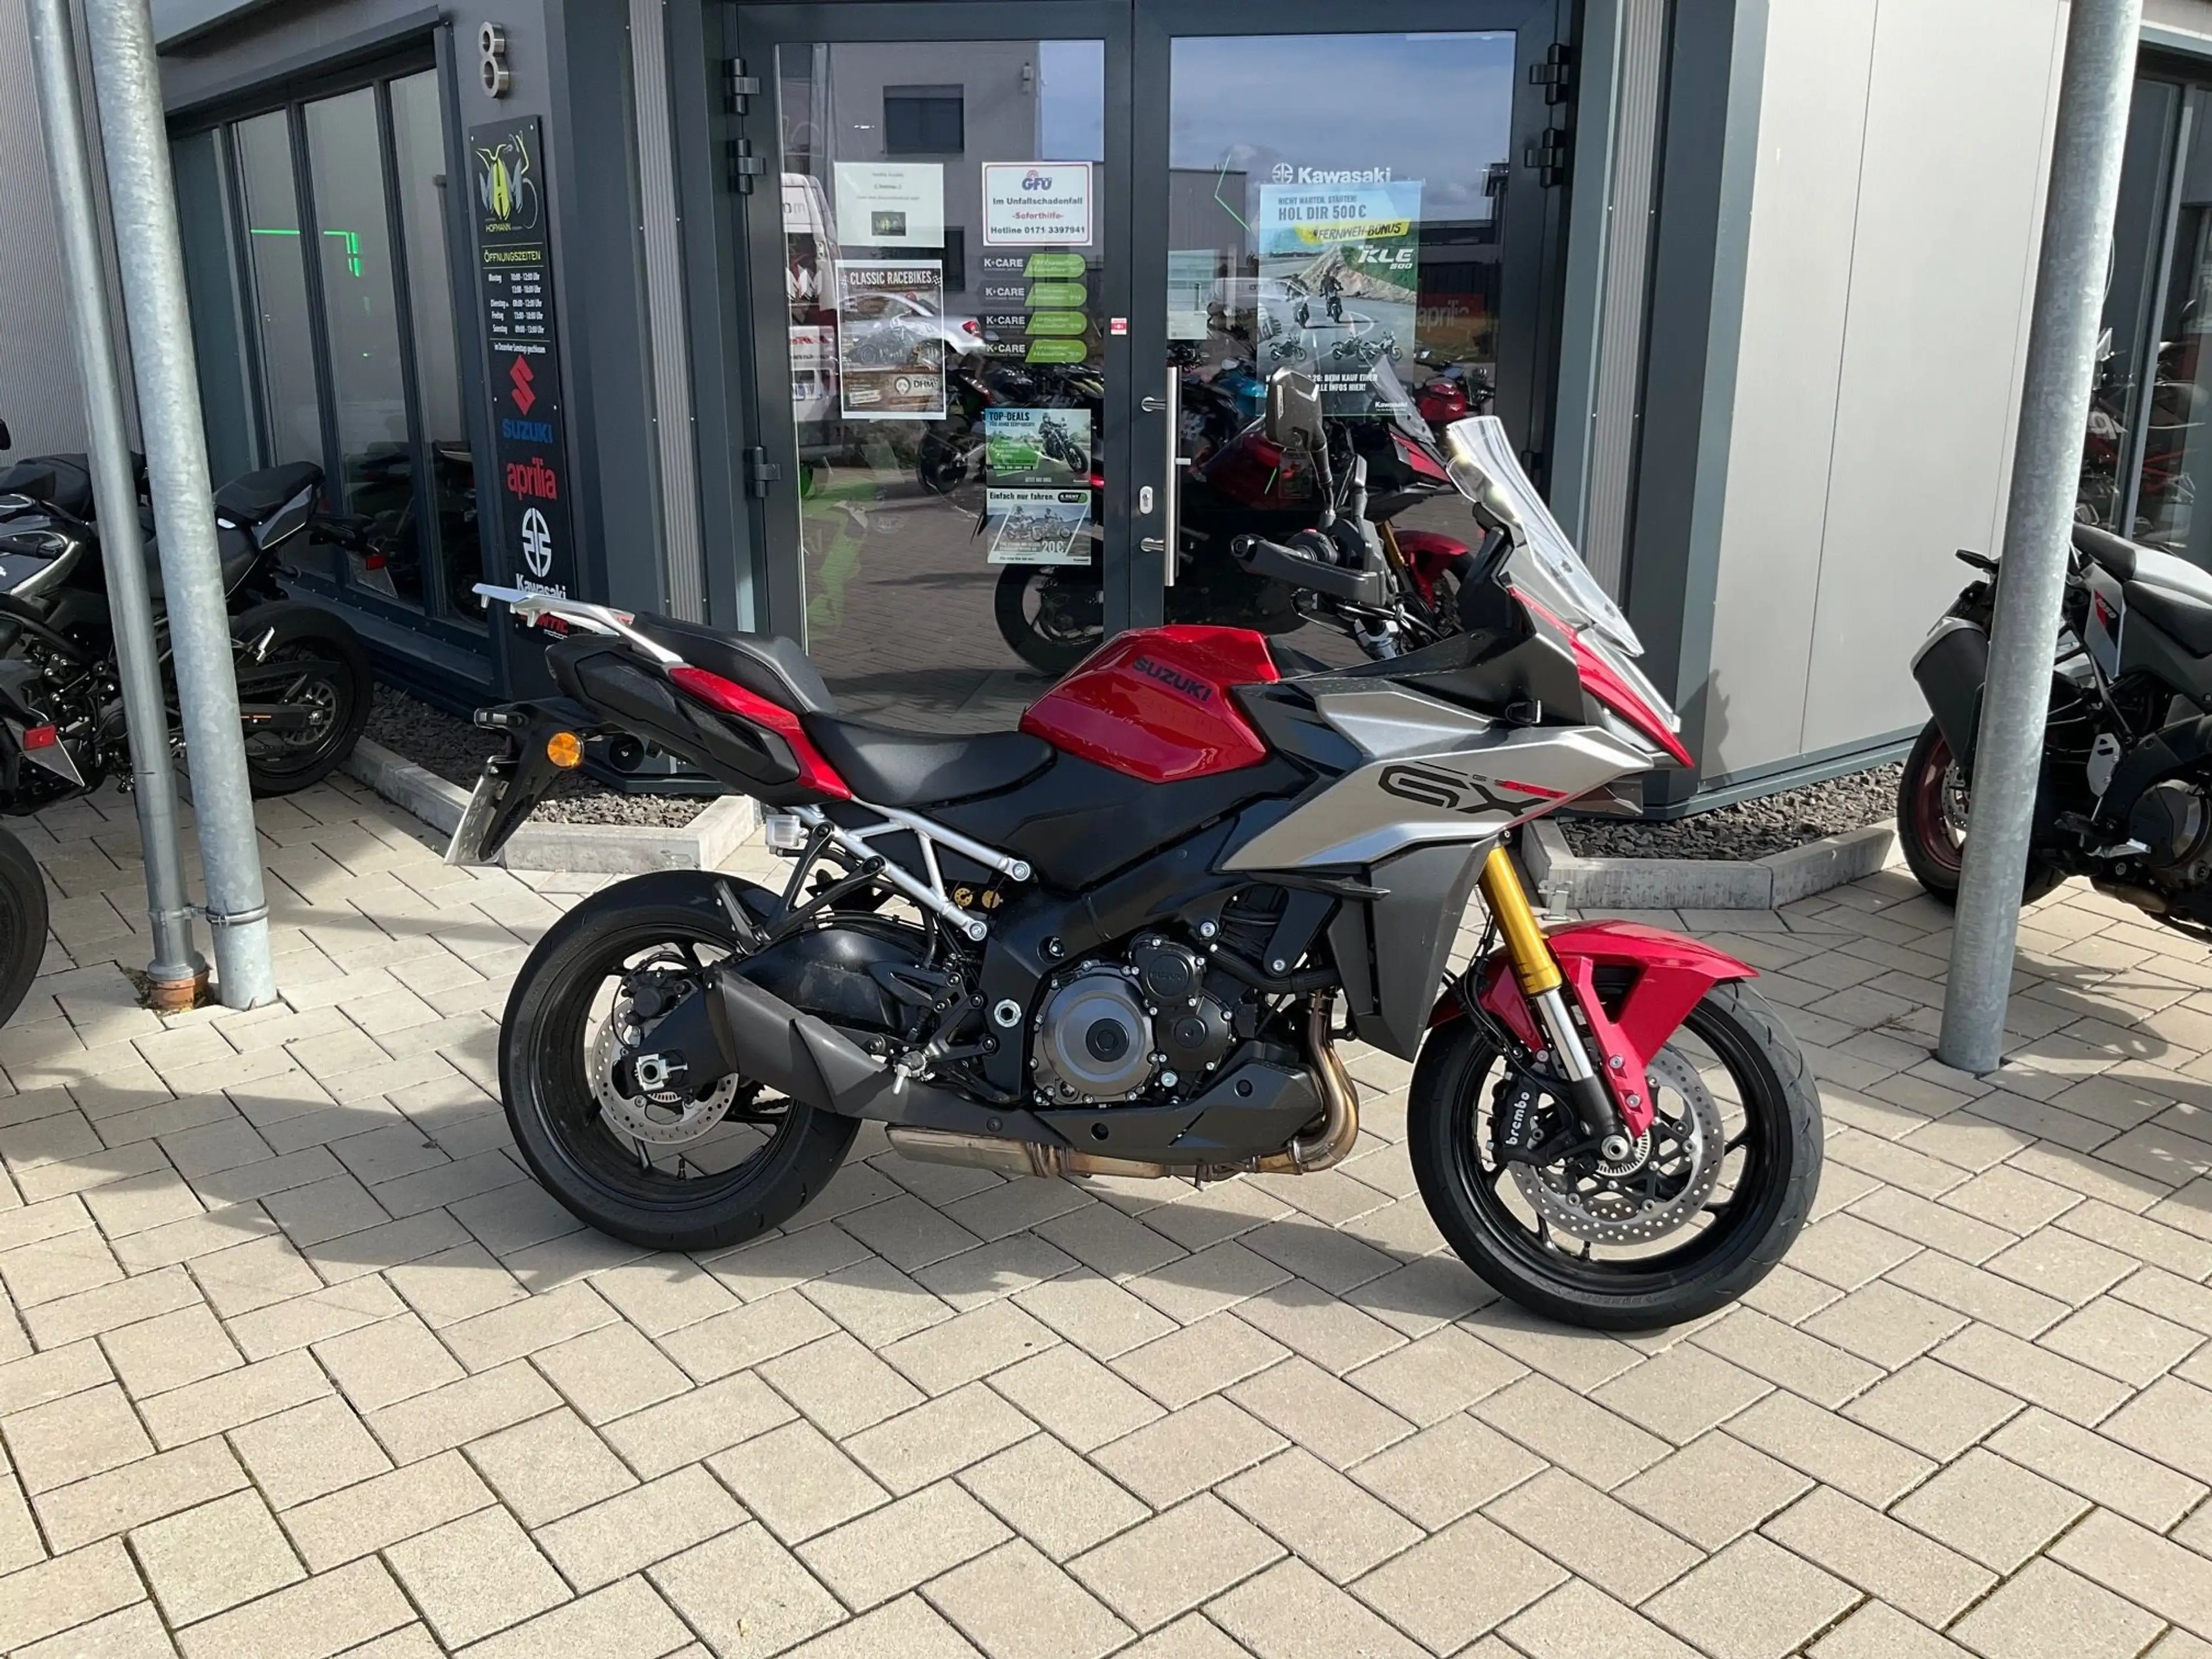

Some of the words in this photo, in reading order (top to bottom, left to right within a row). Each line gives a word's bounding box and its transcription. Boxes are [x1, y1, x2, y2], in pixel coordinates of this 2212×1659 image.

[478, 21, 507, 99] 8
[1297, 166, 1391, 184] Kawasaki
[993, 198, 1004, 206] Im
[1007, 196, 1083, 206] Unfallschadenfall
[1279, 207, 1302, 221] HOL
[1306, 206, 1328, 220] DIR
[990, 226, 1022, 234] Hotline
[1025, 226, 1045, 234] 0171
[483, 249, 541, 263] ÖFFNUNGSZEITEN
[1358, 248, 1414, 263] KLE
[850, 271, 885, 285] CLASSIC
[887, 270, 933, 285] RACEBIKES
[990, 411, 1030, 421] TOP-DEALS
[502, 418, 554, 444] SUZUKI
[506, 456, 558, 501] aprilia
[990, 491, 1014, 500] Einfach
[1030, 491, 1055, 500] fahren.
[516, 573, 566, 600] Kawasaki
[1132, 656, 1212, 702] SUZUKI
[1505, 1092, 1530, 1145] brembo
